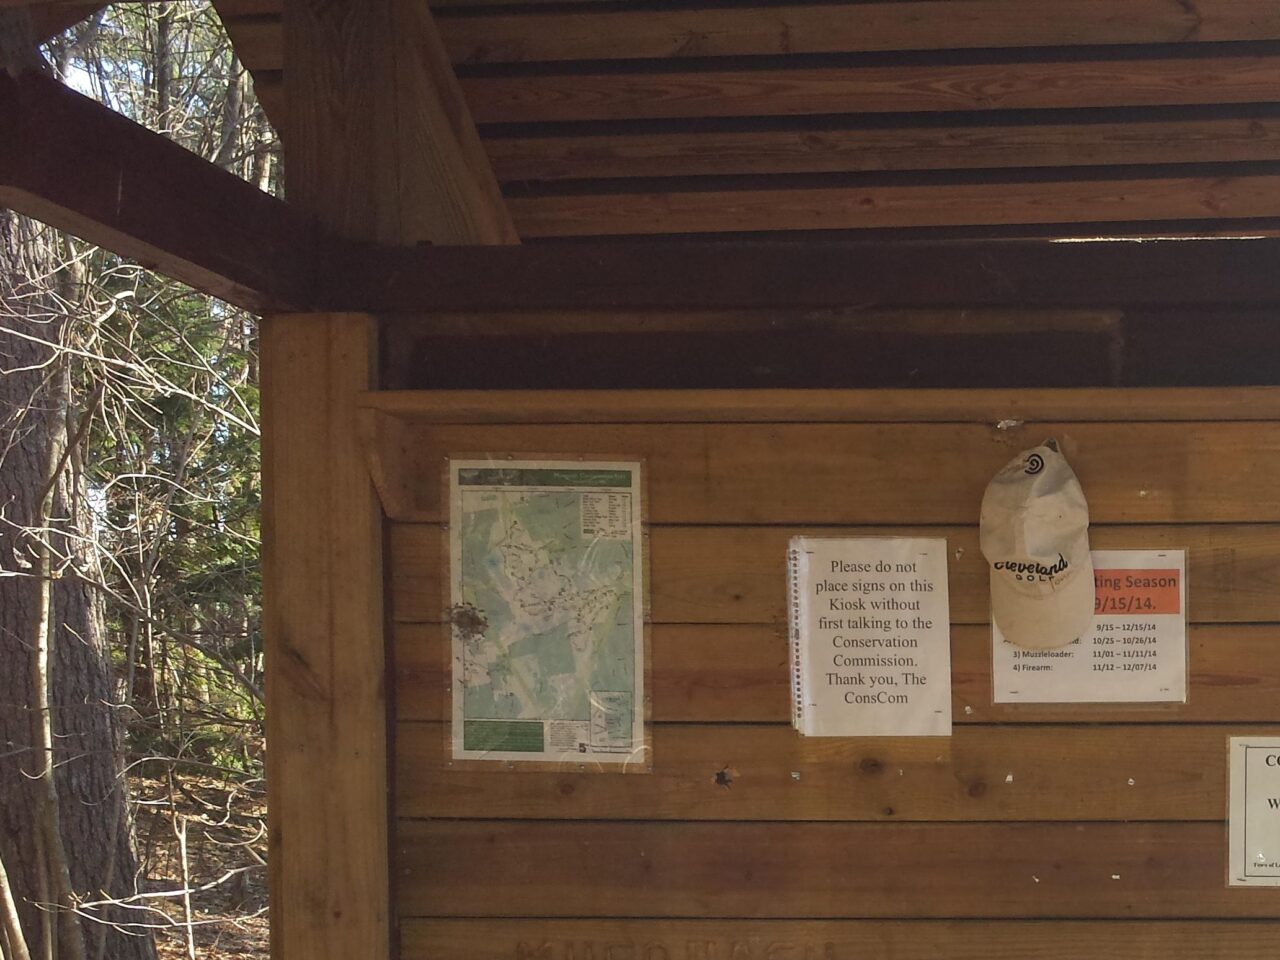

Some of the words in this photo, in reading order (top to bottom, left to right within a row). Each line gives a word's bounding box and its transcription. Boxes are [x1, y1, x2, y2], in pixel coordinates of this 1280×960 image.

[831, 561, 871, 573] Please
[875, 561, 892, 573] do
[895, 562, 917, 573] not
[815, 580, 848, 595] place
[852, 579, 885, 595] signs
[889, 582, 905, 591] on
[910, 579, 934, 592] this
[1125, 576, 1177, 588] Season
[829, 598, 866, 611] Kiosk
[870, 598, 920, 611] without
[819, 617, 844, 629] first
[847, 617, 892, 632] talking
[895, 618, 909, 630] to
[912, 617, 934, 630] the
[1096, 624, 1114, 632] 9/15
[1122, 624, 1156, 632] 12/15/14
[832, 635, 918, 649] Conservation
[1093, 637, 1115, 645] 10/25
[1122, 637, 1157, 645] 10/26/14
[833, 654, 918, 667] Commission.
[1013, 651, 1021, 659] 3)
[1022, 650, 1074, 658] Muzzleloader:
[1093, 650, 1115, 658] 11/01
[1122, 650, 1157, 658] 11/11/14
[1013, 664, 1021, 672] 4)
[1022, 664, 1053, 672] Firearm:
[1093, 664, 1115, 672] 11/12
[1122, 664, 1157, 672] 12/07/14
[825, 672, 865, 686] Thank
[869, 676, 898, 689] you,
[902, 673, 927, 686] The
[844, 691, 909, 705] ConsCom
